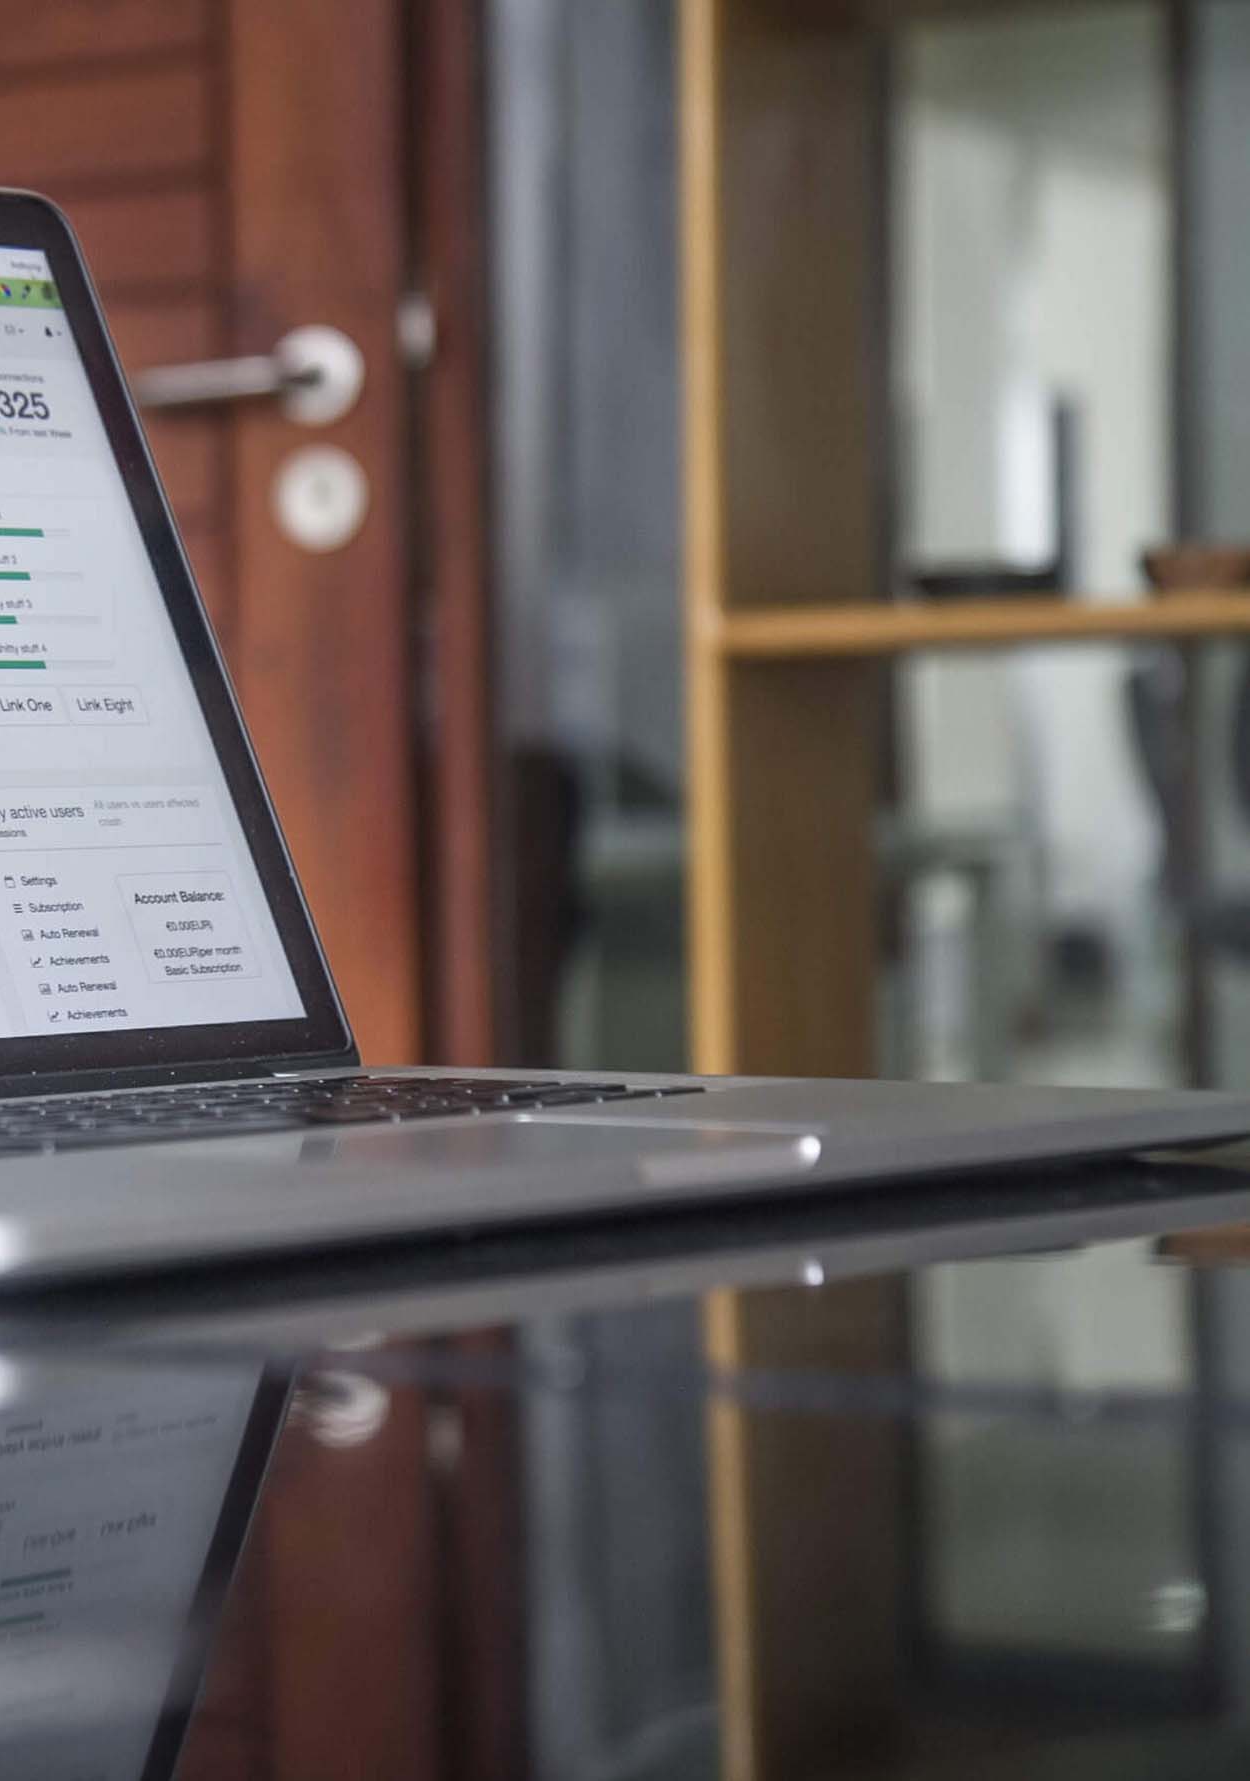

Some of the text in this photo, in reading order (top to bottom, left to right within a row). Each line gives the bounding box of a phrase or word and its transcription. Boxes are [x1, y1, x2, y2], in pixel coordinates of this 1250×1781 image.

[5, 599, 25, 609] stuff
[20, 644, 40, 654] stuff
[0, 697, 53, 712] Link One
[77, 697, 134, 714] Link Eight
[10, 805, 47, 820] active
[50, 804, 85, 819] users
[20, 875, 58, 889] Settings
[134, 890, 225, 905] Account Balance:
[29, 900, 84, 915] Subscription
[40, 927, 100, 940] Auto Renewal
[49, 953, 111, 967] Achievements
[165, 963, 243, 976] Basic Subscription
[57, 980, 117, 994] Auto Renewal
[67, 1007, 128, 1021] Achievements
